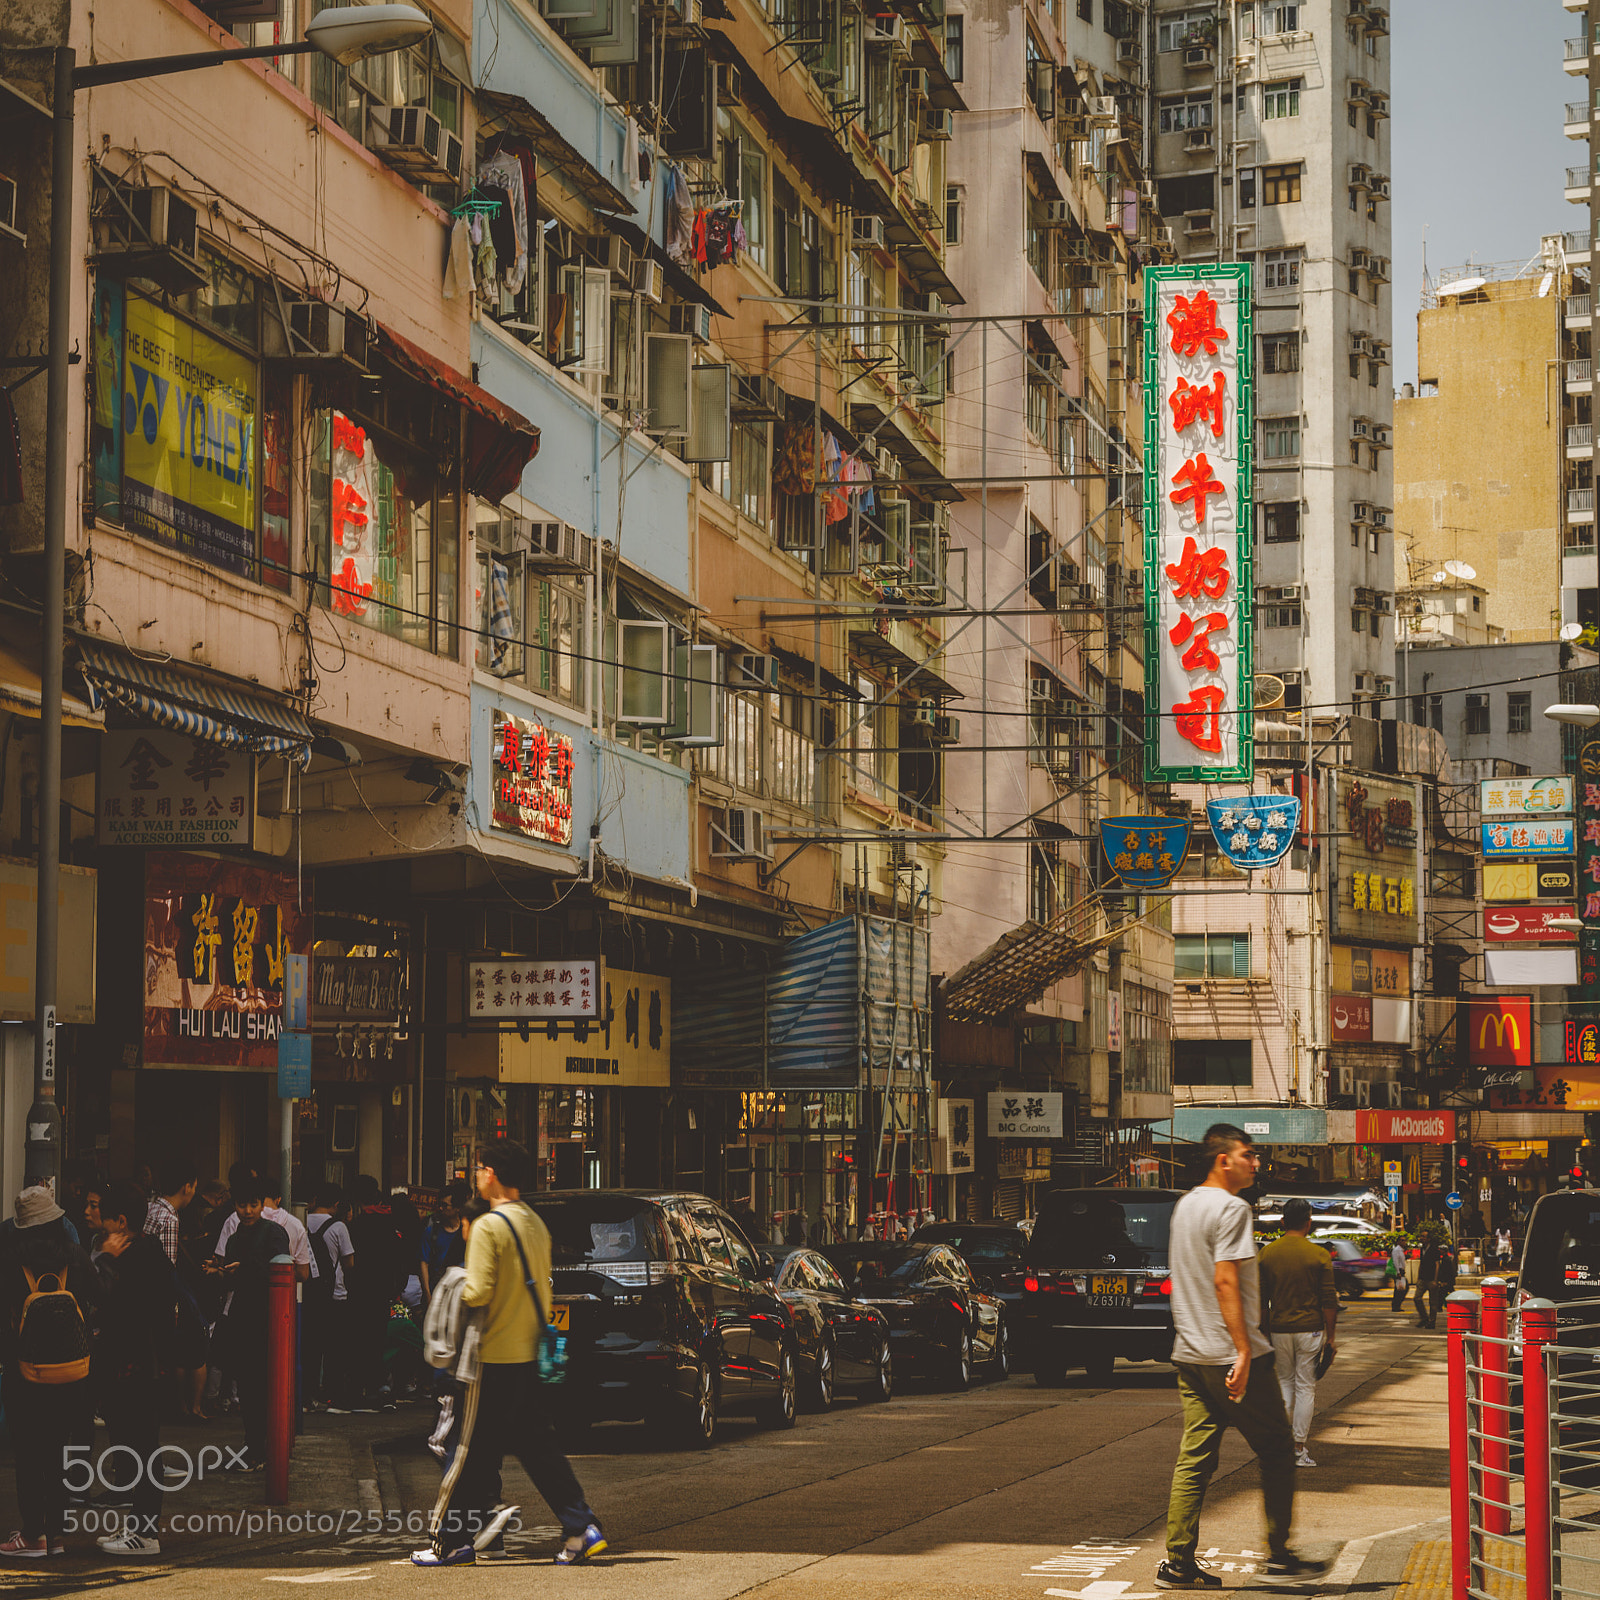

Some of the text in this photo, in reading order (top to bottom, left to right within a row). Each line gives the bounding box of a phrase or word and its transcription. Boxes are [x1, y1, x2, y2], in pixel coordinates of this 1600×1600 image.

[143, 338, 166, 367] BEST
[168, 352, 215, 394] RECOGNISE
[175, 385, 253, 491] YONEX
[1166, 290, 1230, 753] 澳洲牛奶公司
[120, 737, 231, 792] 金華
[104, 796, 245, 818] 服裝用品公司
[501, 778, 572, 820] Relaxed Place
[1488, 788, 1565, 808] 蒸氣石鍋
[108, 819, 239, 831] KAM WAH FASHION
[1490, 824, 1565, 847] 富臨漁港
[115, 832, 233, 844] ACCESSORIES CO.
[319, 962, 345, 1006] Man
[492, 968, 573, 986] 蛋白燉鮮奶
[290, 961, 304, 1022] P
[492, 990, 574, 1008] 杏汁燉雞蛋
[580, 967, 591, 1010] 咖啡紅茶
[179, 1008, 205, 1037] HUI
[211, 1010, 241, 1038] LAU
[45, 1010, 55, 1078] AB 4148
[998, 1122, 1051, 1133] BIG Grains
[1391, 1117, 1445, 1137] McDonald's
[1096, 1284, 1124, 1294] 3163
[1103, 1275, 1118, 1285] SD
[1564, 1278, 1600, 1286] Continental
